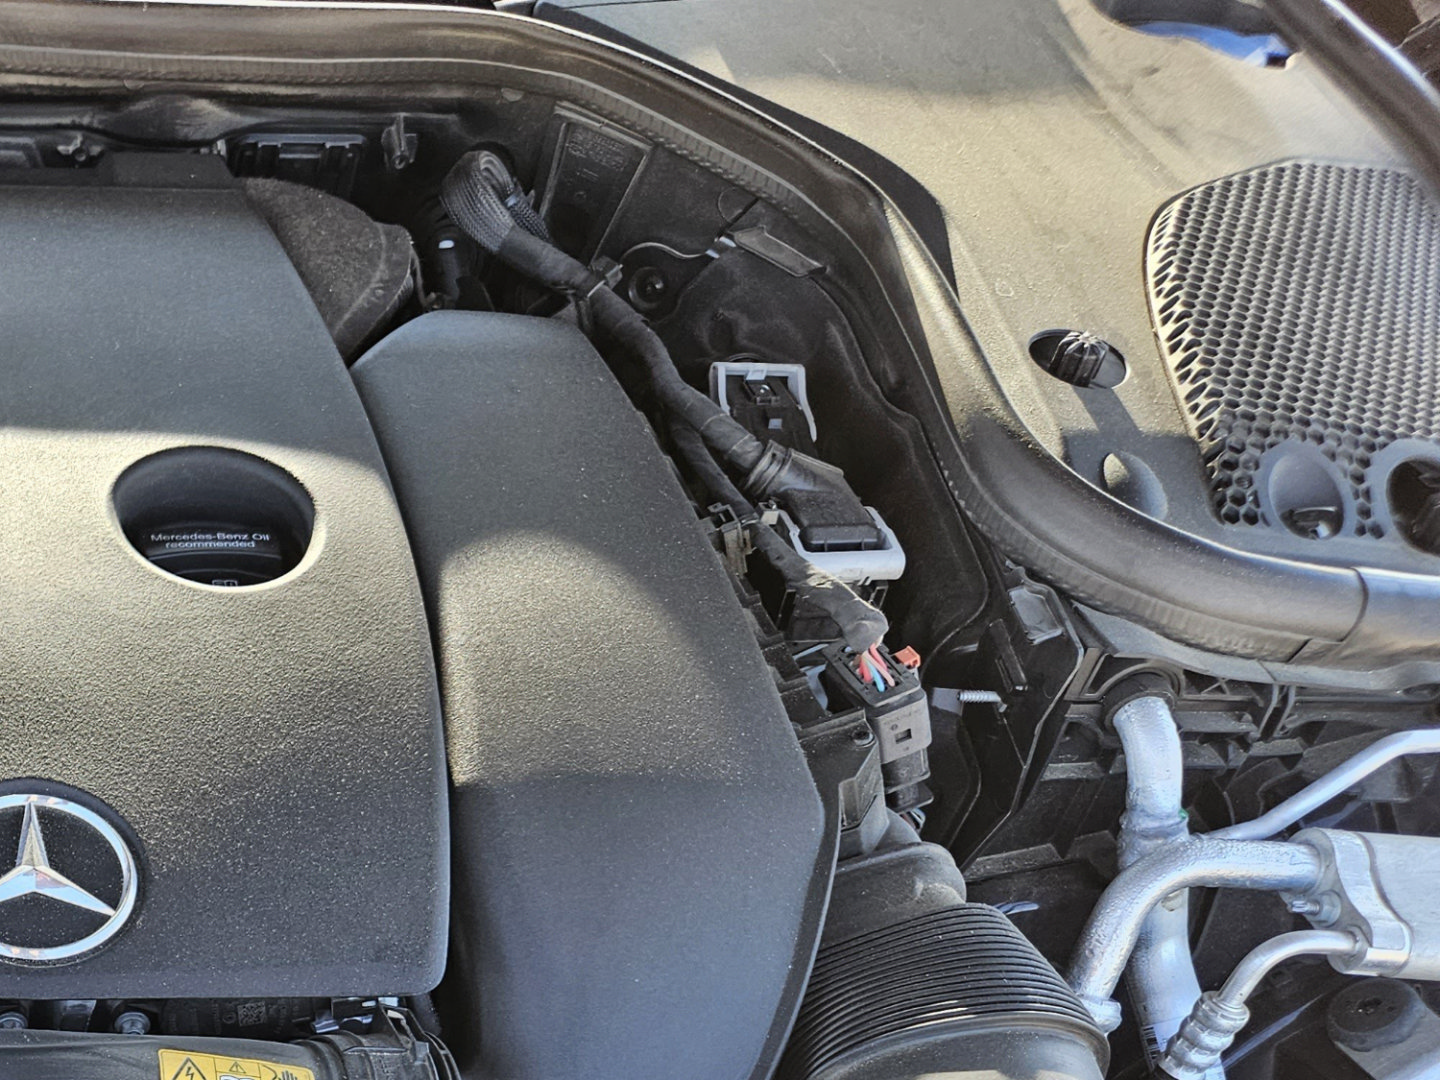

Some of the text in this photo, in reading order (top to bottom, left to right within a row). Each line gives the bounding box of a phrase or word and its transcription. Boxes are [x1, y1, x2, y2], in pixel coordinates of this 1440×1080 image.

[150, 532, 270, 541] Mercedes-Benz Oil
[165, 540, 256, 549] recommended
